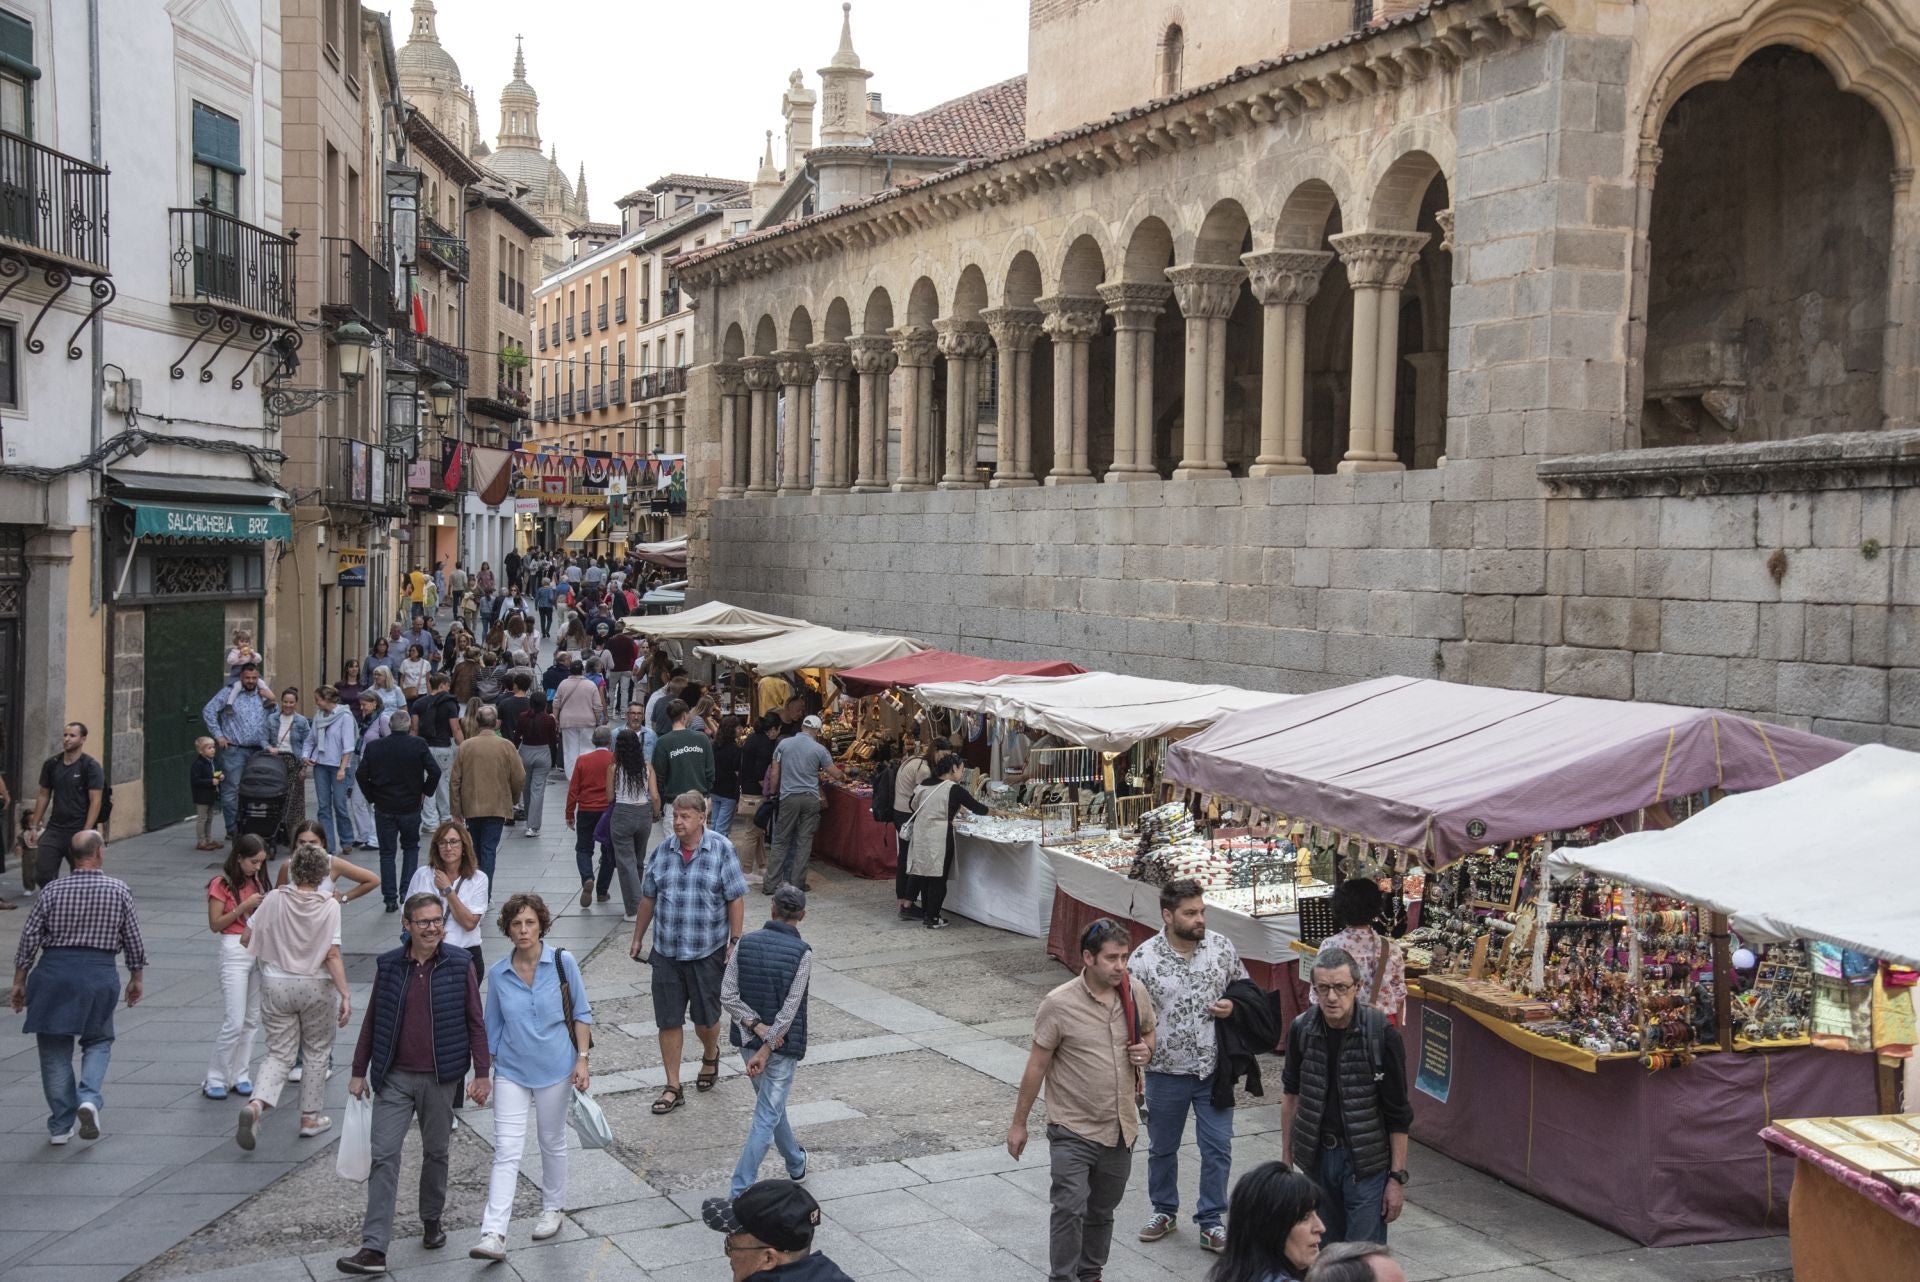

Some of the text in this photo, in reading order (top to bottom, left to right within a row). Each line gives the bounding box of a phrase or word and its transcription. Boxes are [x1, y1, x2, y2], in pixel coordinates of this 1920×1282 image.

[167, 512, 269, 534] SALCHICHERIA BRIZ
[339, 553, 366, 564] ATM
